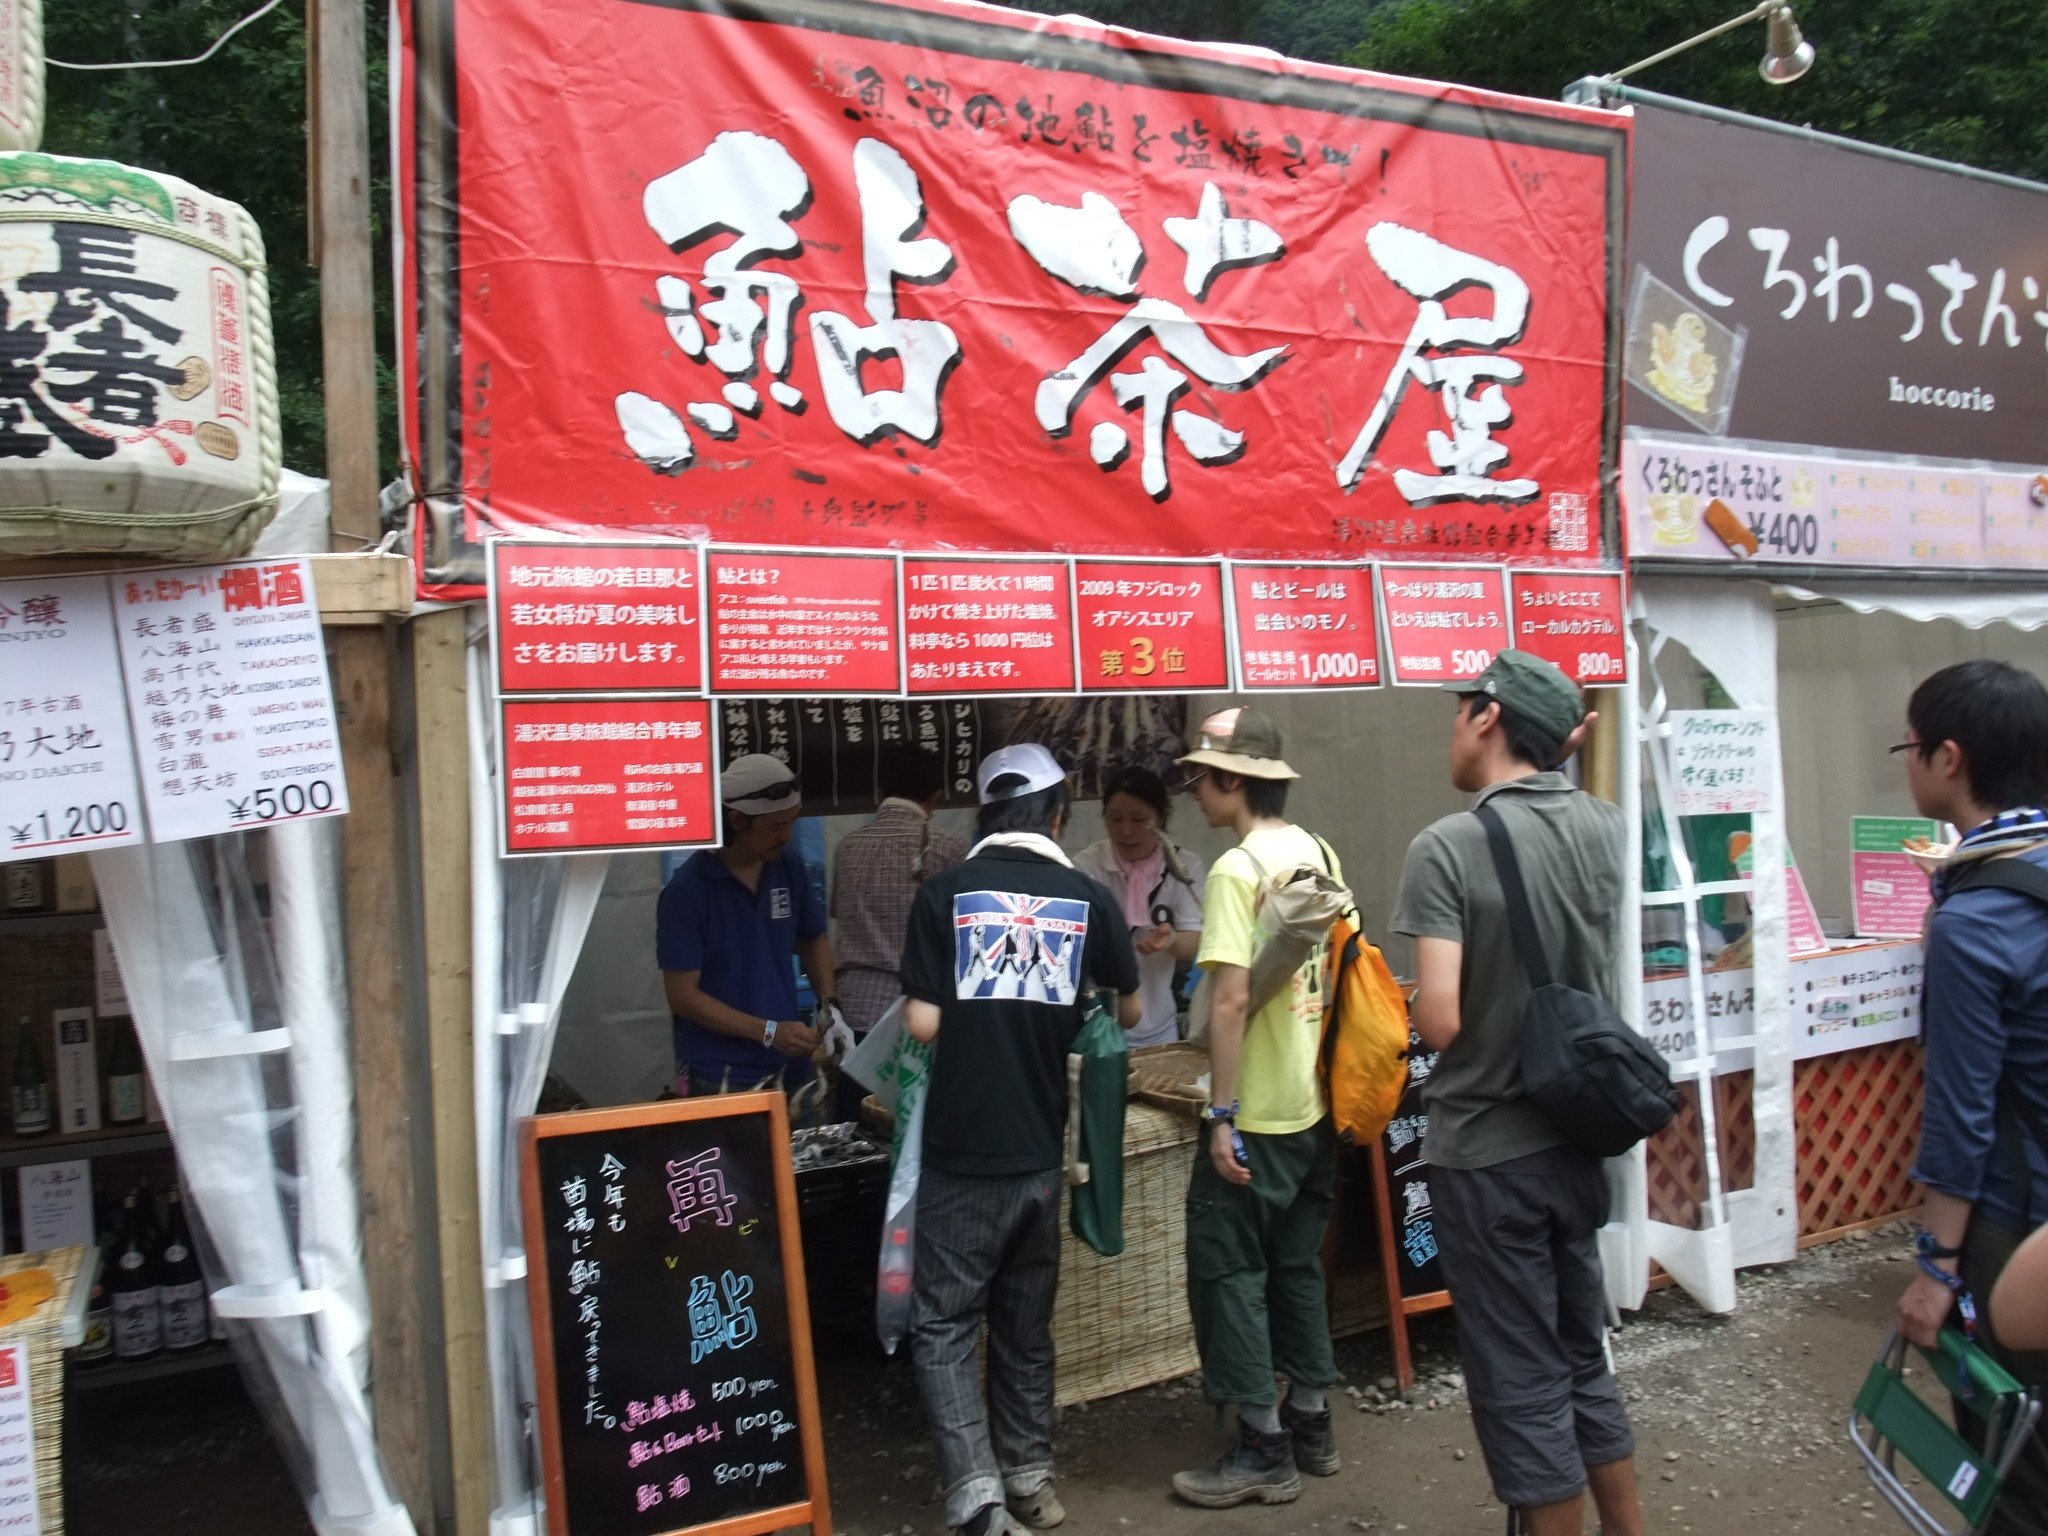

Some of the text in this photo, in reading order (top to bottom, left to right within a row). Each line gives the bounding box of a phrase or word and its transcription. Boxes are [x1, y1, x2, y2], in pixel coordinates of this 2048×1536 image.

[614, 130, 1543, 507] 鮎茶屋
[1888, 376, 1996, 413] hoccorie
[1641, 455, 1784, 502] くろわっさんそふと
[1749, 511, 1819, 556] ¥400
[509, 565, 695, 589] 地元旅館の若旦那と
[716, 566, 782, 586] 鮎とは?
[1251, 581, 1347, 600] 鮎とビールは
[1384, 579, 1486, 600] やっぱり湯沢の夏
[1520, 590, 1602, 608] ちょいとここで
[133, 612, 219, 639] 長者盛
[510, 603, 696, 626] 若女将が夏の美味し
[1091, 610, 1195, 628] オアシスエリア
[1254, 613, 1358, 633] 出会いのモノ。
[1391, 611, 1505, 629] といえば鮎でしょう。
[139, 638, 221, 660] 八海山
[235, 632, 316, 649] HAKKAISAN
[513, 642, 687, 665] さをお届けします。
[1099, 636, 1187, 677] 第3位
[1577, 653, 1623, 676] 800円
[909, 661, 1022, 679] あたりまえです。
[1299, 652, 1376, 684] 1,000円
[513, 721, 703, 742] 湯沢温泉旅館組合青年部
[32, 760, 105, 780] DAICHI
[227, 780, 334, 822] ¥500
[9, 801, 128, 843] ¥1,200
[599, 1152, 628, 1233] 今年も
[686, 1268, 758, 1365] 鮎
[711, 1376, 747, 1402] 500
[735, 1408, 784, 1436] 1000
[712, 1462, 756, 1487] 800
